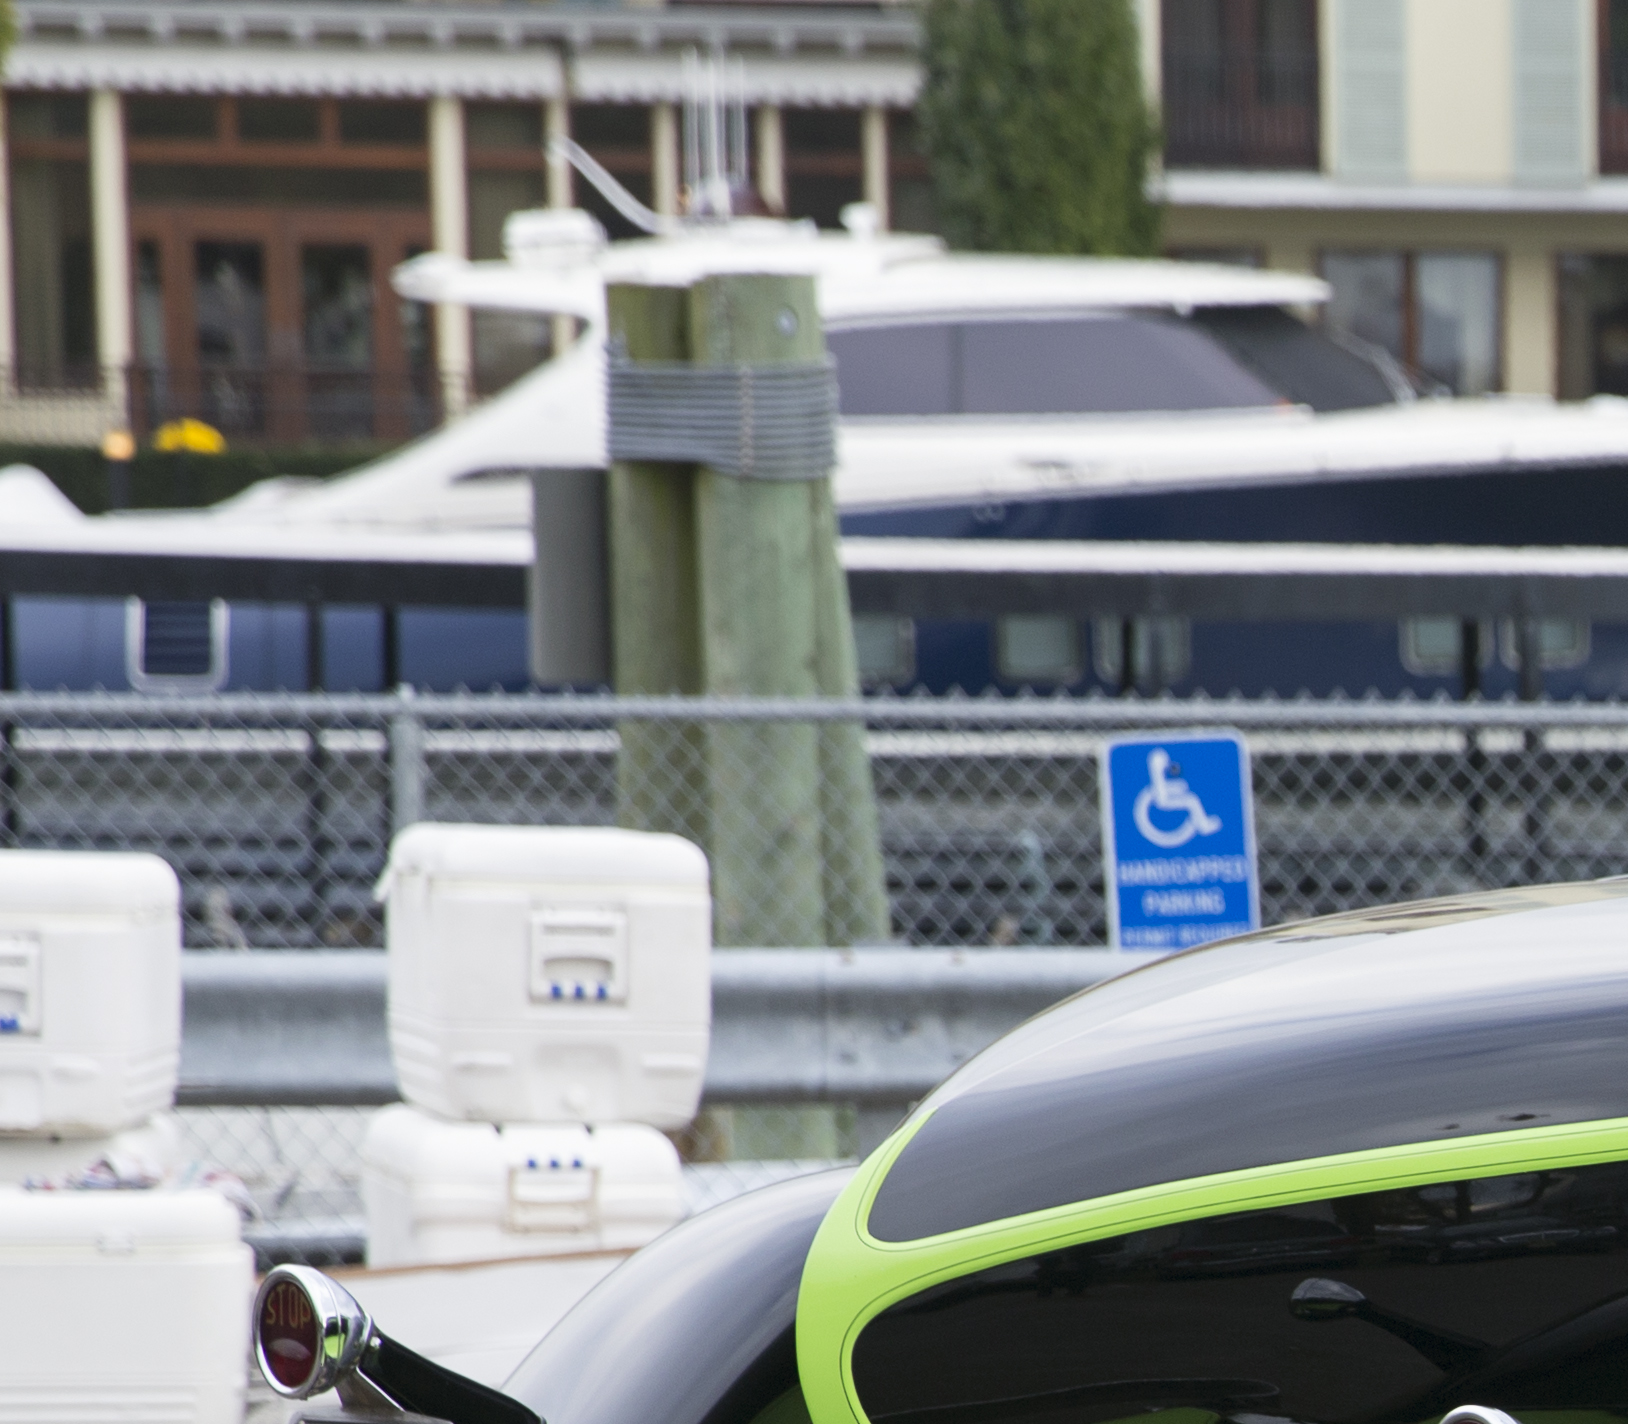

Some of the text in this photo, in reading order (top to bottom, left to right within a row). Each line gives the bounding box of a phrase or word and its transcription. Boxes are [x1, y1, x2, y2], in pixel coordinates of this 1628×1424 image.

[1120, 857, 1247, 885] HANDICAPPED
[1142, 887, 1225, 916] PARKING
[266, 1283, 311, 1329] STOP
